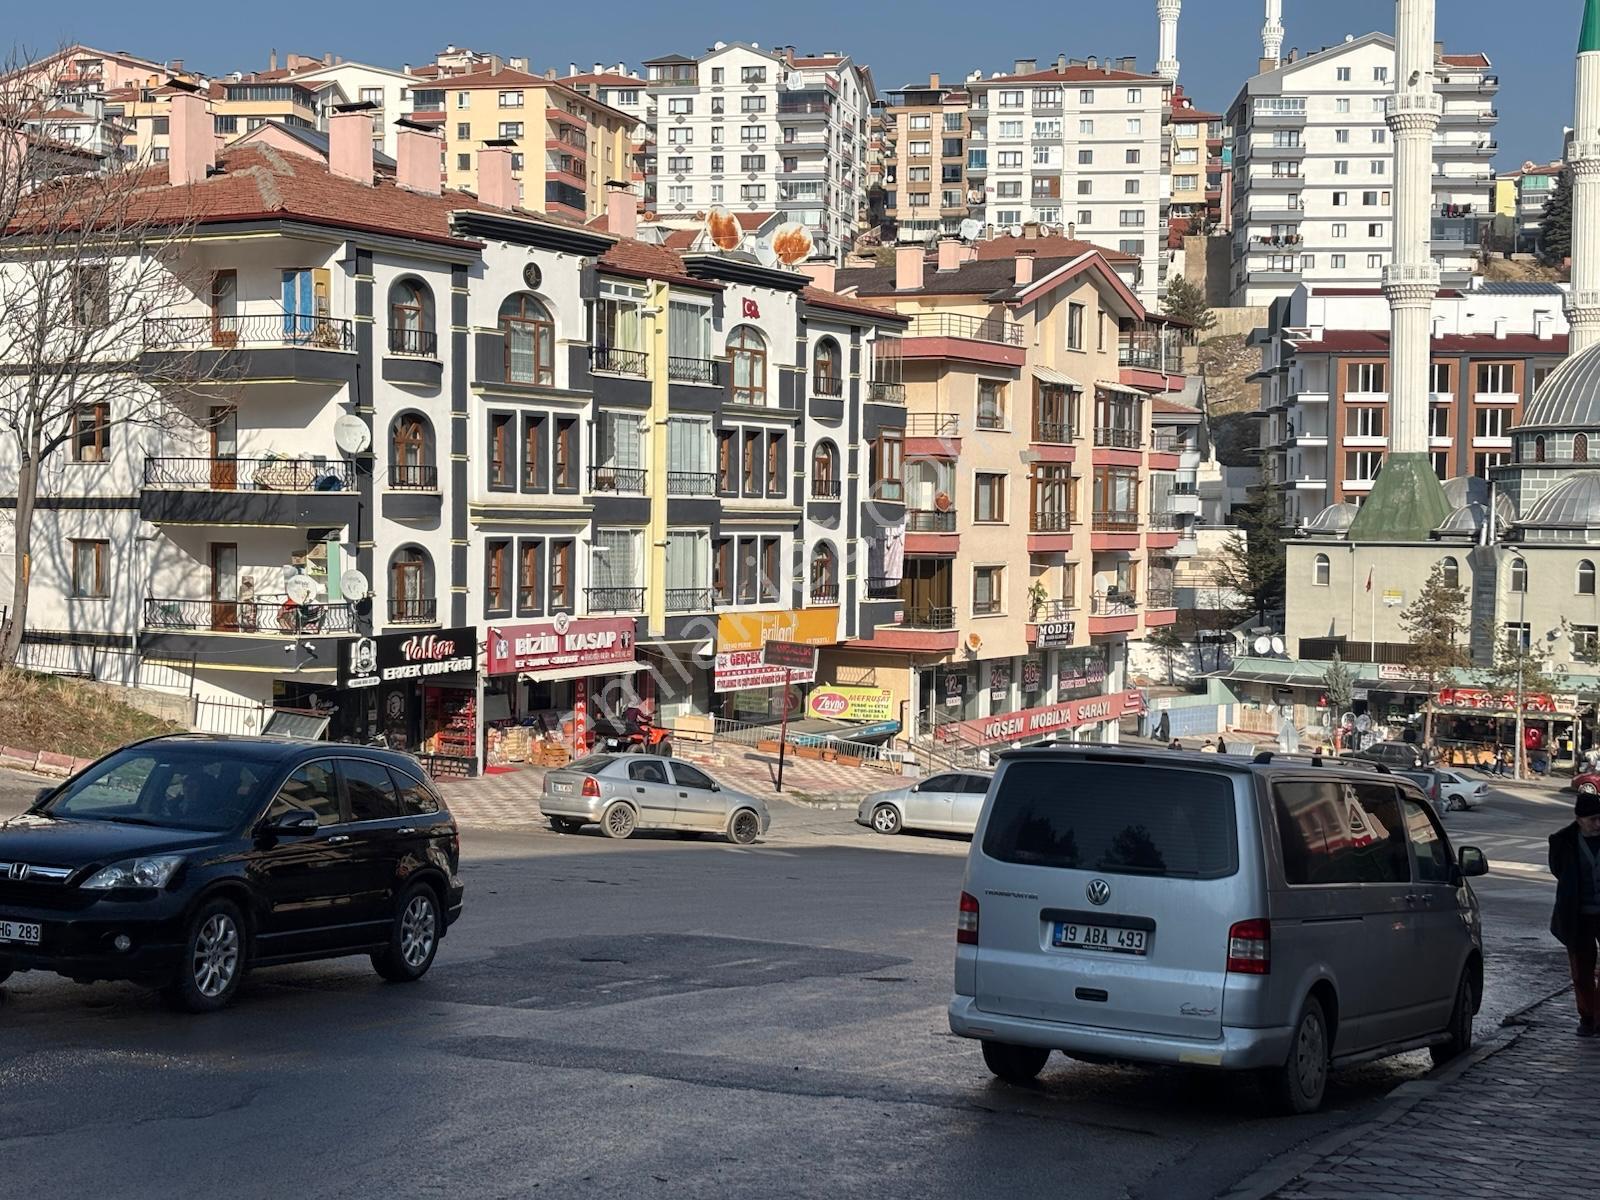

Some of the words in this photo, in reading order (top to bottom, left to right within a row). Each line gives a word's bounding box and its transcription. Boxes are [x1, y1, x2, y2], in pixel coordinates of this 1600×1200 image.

[1039, 623, 1074, 635] MODEL
[401, 635, 455, 660] Volkan
[515, 632, 558, 655] BİZİM
[565, 631, 617, 651] KASAP
[730, 652, 761, 667] GERÇEK
[383, 664, 421, 681] ERKEK
[817, 696, 845, 712] Zeyno
[577, 701, 586, 757] KASAP
[985, 718, 1024, 739] KÖŞEM
[1029, 707, 1071, 730] MOBİLYA
[1078, 700, 1110, 720] SARAYI
[18, 924, 39, 940] 283
[1063, 925, 1077, 941] 19
[1083, 927, 1108, 945] ABA
[1117, 931, 1143, 948] 493
